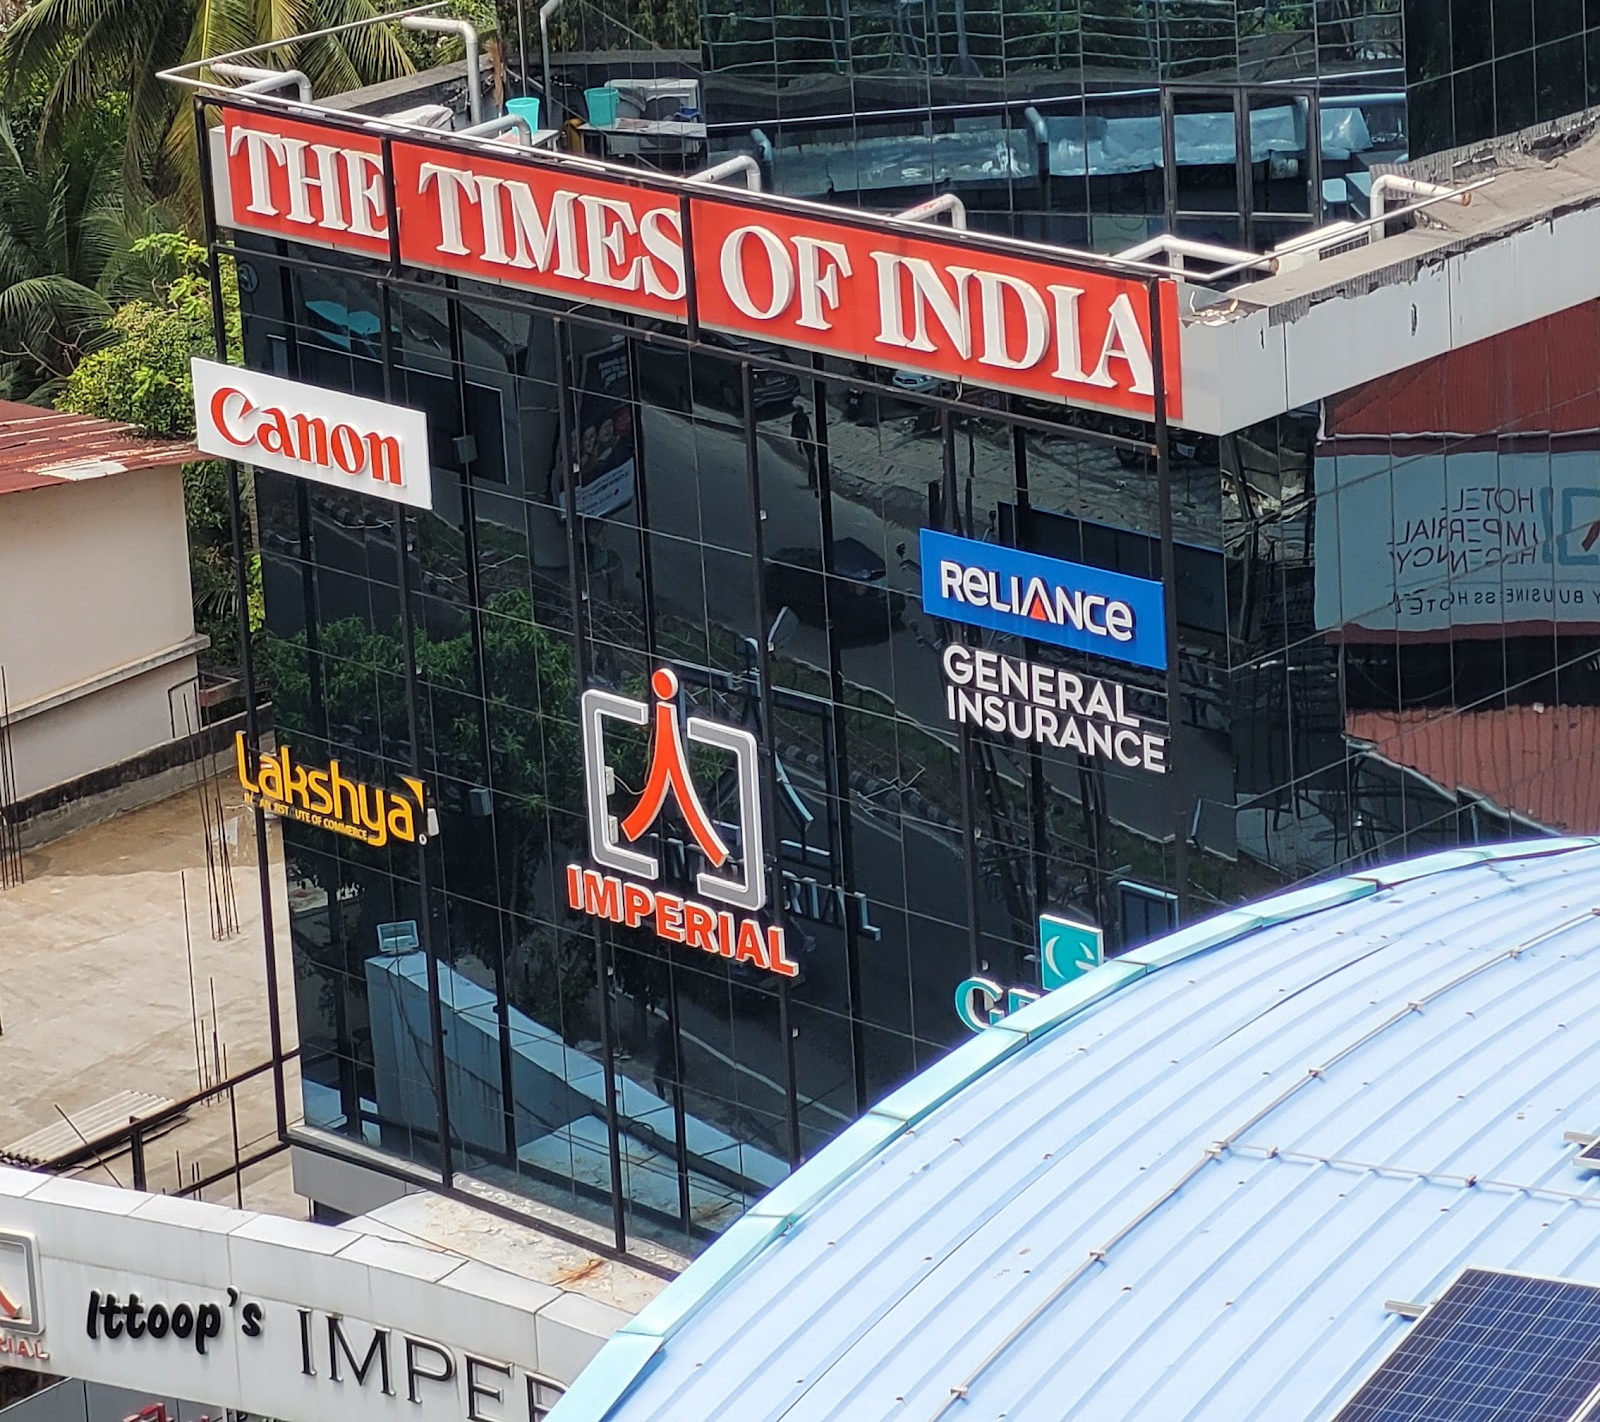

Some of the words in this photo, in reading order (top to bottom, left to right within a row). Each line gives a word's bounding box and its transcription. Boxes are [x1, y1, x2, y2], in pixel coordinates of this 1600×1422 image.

[230, 125, 400, 239] THE
[419, 161, 686, 301] TIMES
[720, 225, 853, 331] OF
[870, 251, 1167, 396] INDIA
[210, 386, 408, 487] Canon
[943, 644, 1141, 728] GENERAL
[947, 685, 1166, 774] INSURANCE
[235, 731, 415, 847] Lakshya
[566, 864, 798, 977] IMPERIAL
[86, 1285, 264, 1355] Ittoop's
